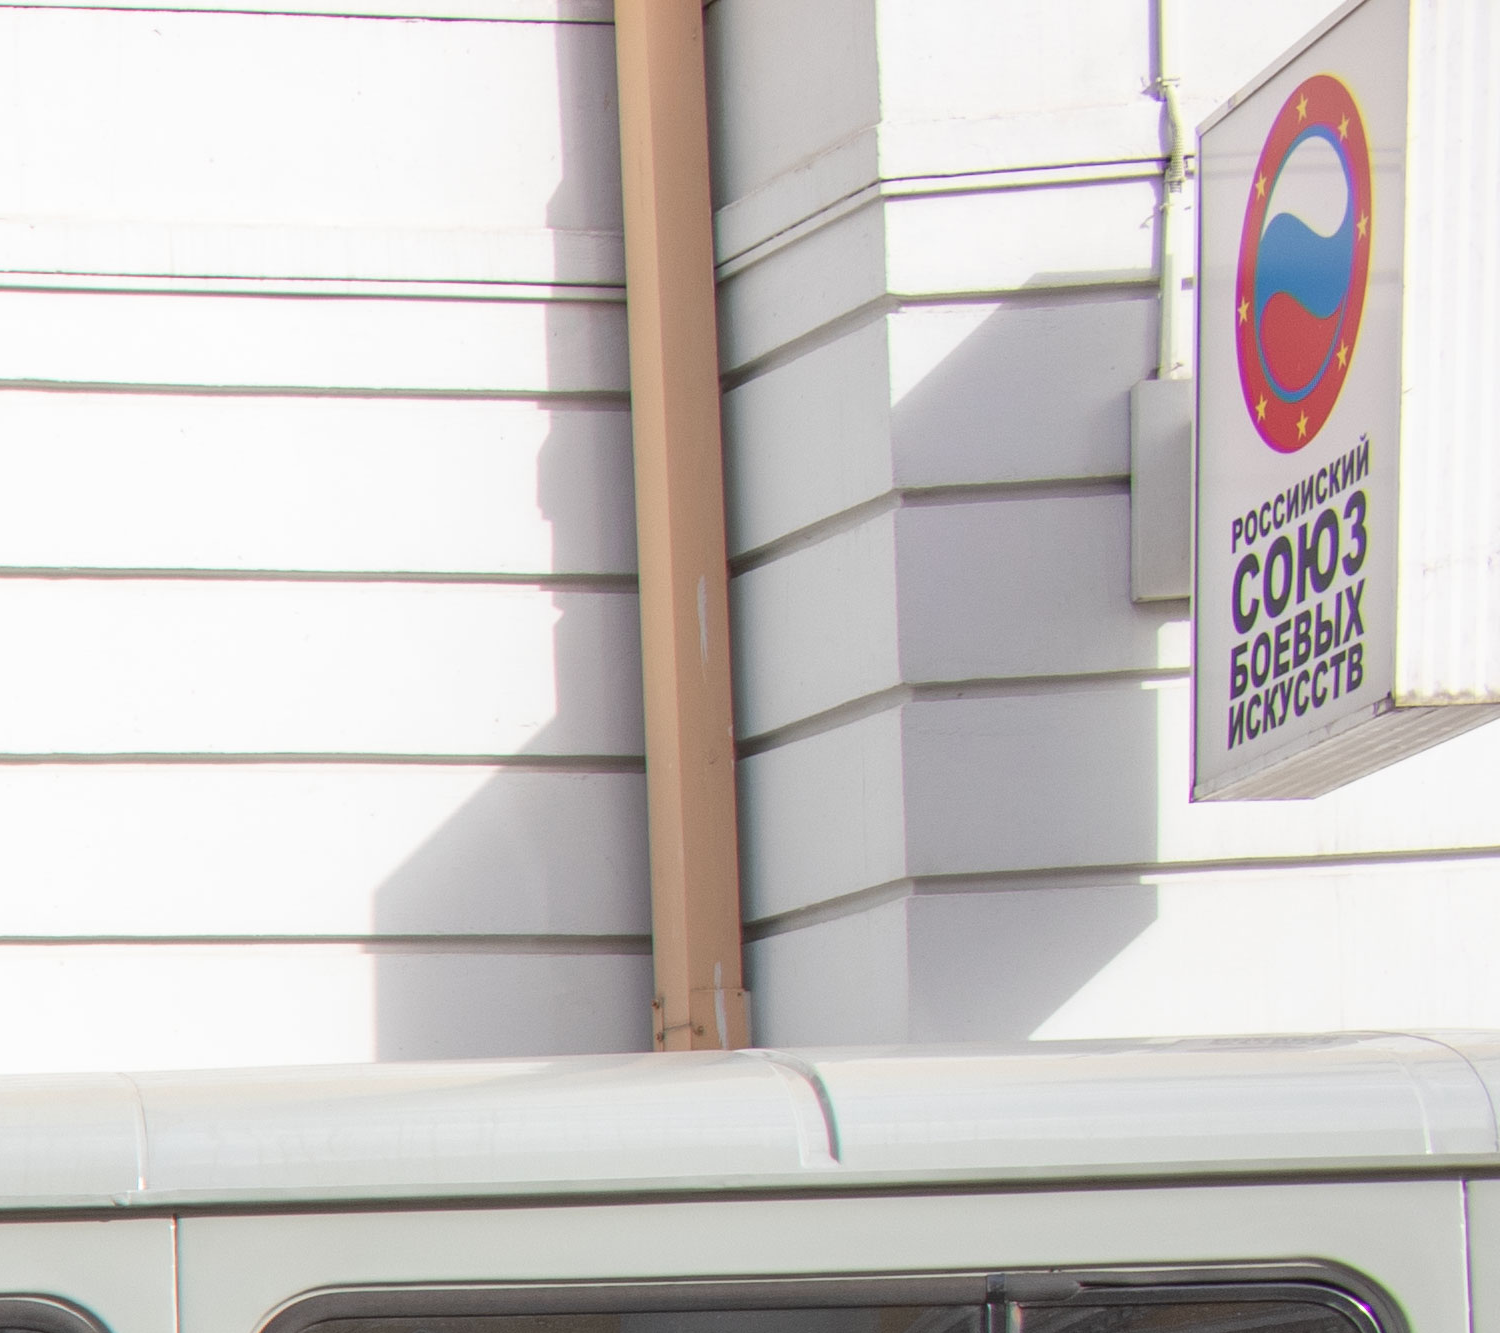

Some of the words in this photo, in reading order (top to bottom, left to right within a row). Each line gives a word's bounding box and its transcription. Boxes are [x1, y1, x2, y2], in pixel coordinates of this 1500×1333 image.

[1231, 489, 1368, 635] СОЮЗ
[1226, 641, 1364, 751] ИСКУССТВ
[1229, 577, 1366, 701] БОЕВЫХ
